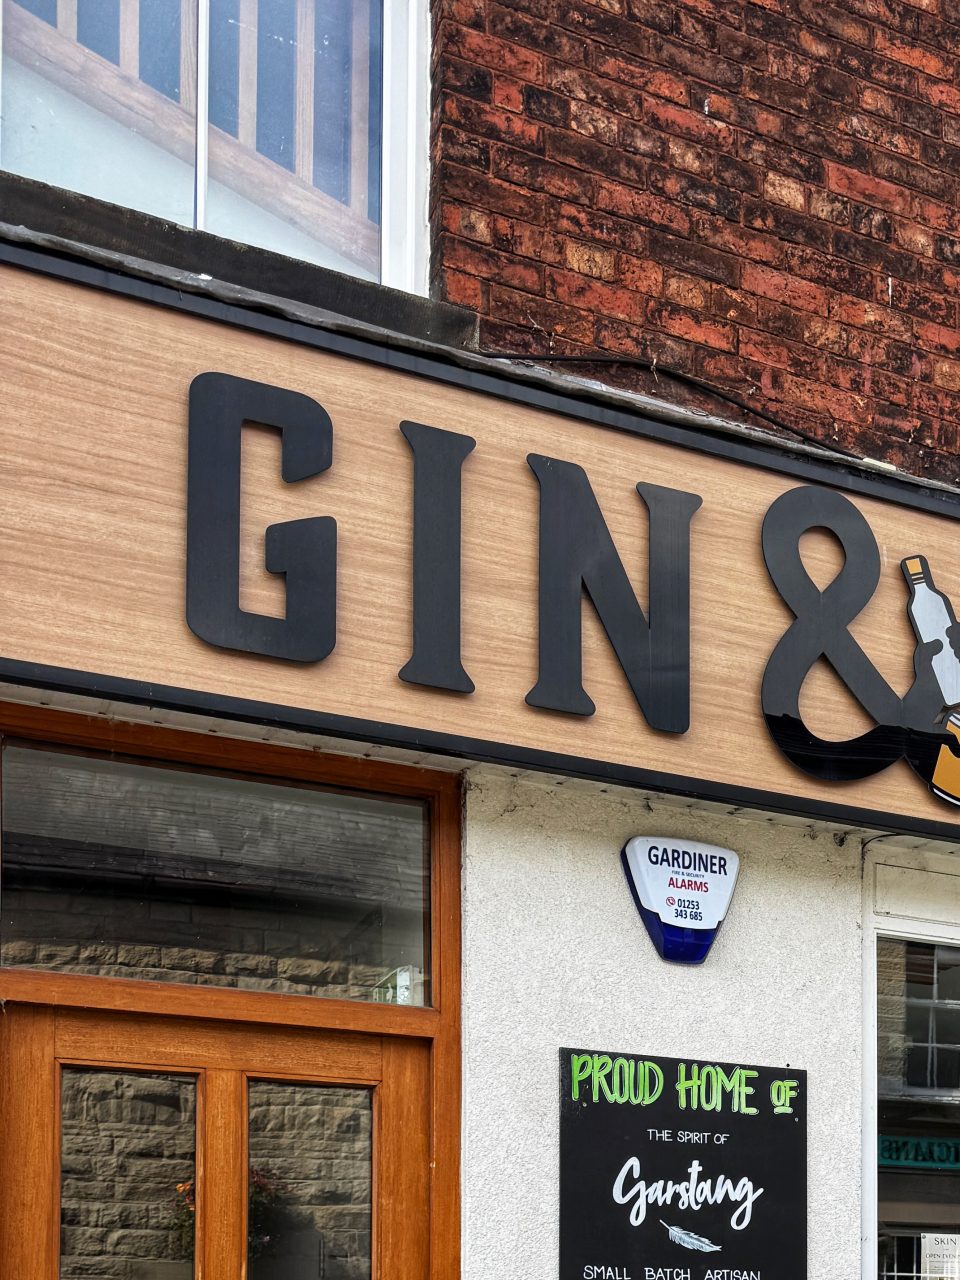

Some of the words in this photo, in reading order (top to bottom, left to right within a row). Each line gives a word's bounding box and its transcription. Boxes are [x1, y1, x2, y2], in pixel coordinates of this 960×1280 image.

[186, 371, 703, 735] GIN
[761, 485, 908, 783] &
[648, 846, 728, 876] GARDINER
[668, 877, 709, 893] ALARMS
[677, 898, 700, 910] 01253
[674, 909, 688, 919] 343
[689, 911, 703, 921] 685
[571, 1054, 664, 1106] PROUD
[676, 1063, 759, 1115] HOME
[770, 1080, 799, 1114] OF
[647, 1129, 673, 1142] THE
[677, 1131, 711, 1144] SPIRIT
[714, 1134, 729, 1145] OF
[612, 1156, 764, 1230] Garstang
[934, 1237, 957, 1246] SKIN
[583, 1265, 631, 1280] SMALL
